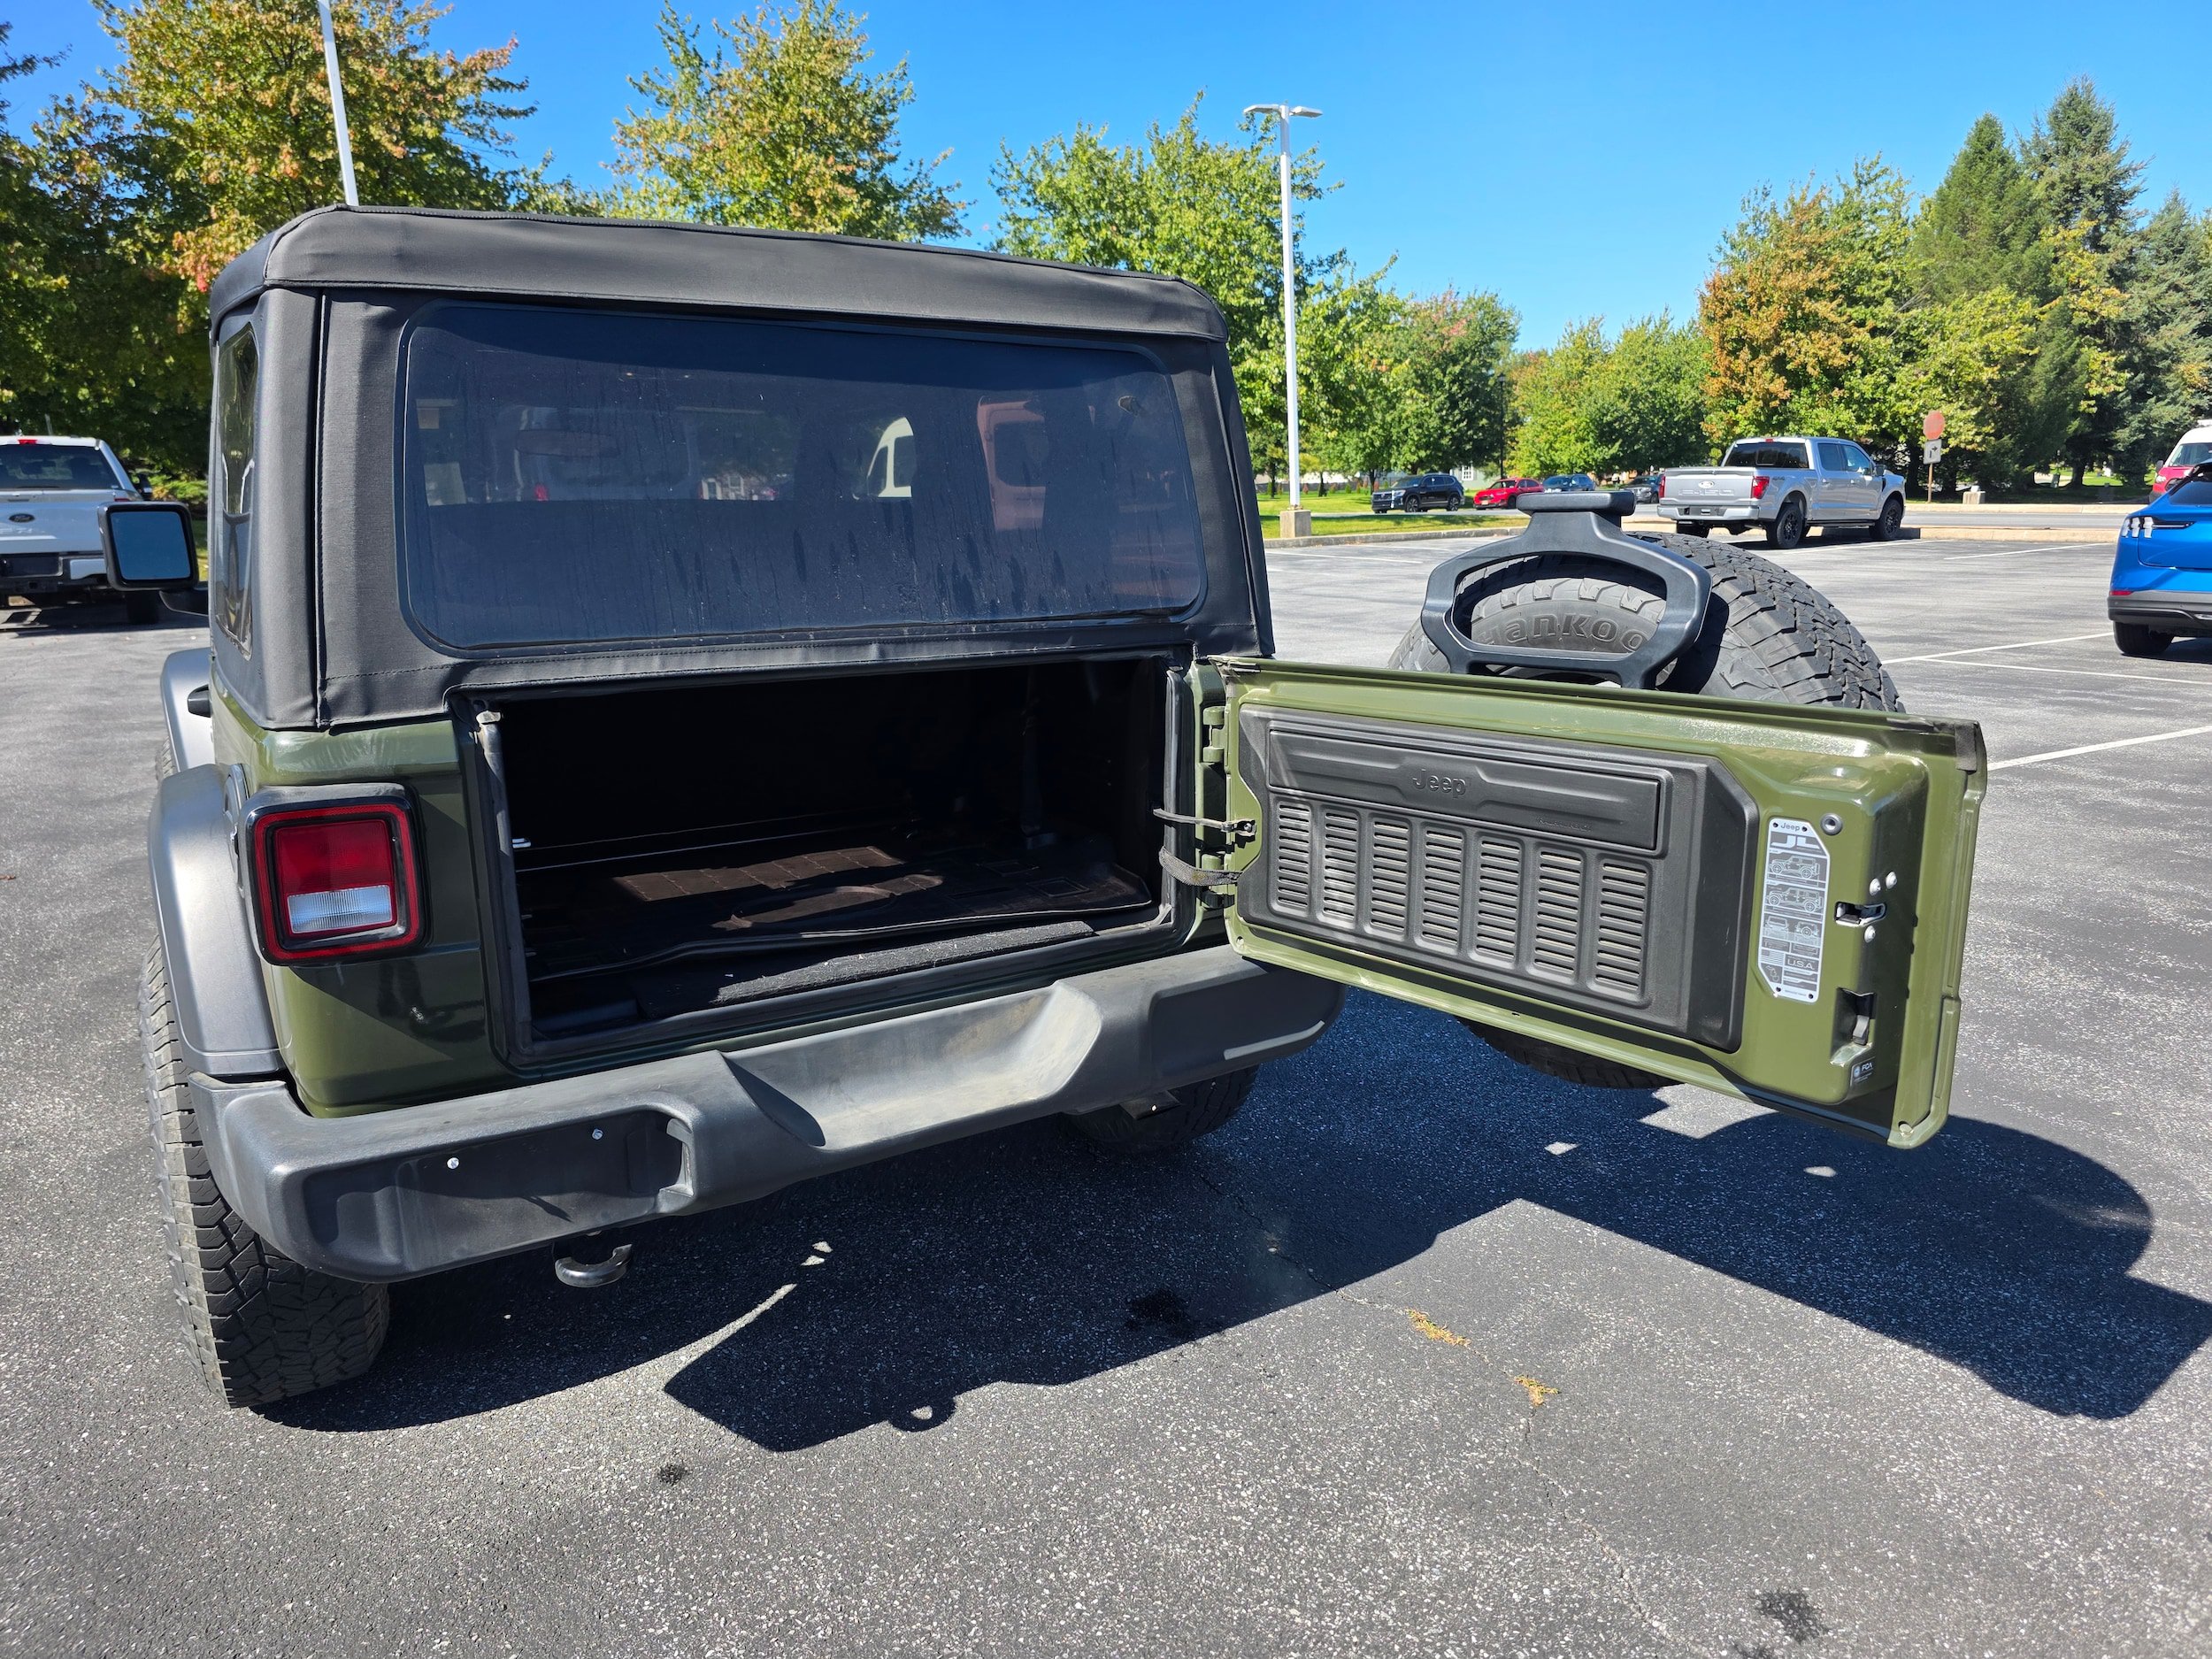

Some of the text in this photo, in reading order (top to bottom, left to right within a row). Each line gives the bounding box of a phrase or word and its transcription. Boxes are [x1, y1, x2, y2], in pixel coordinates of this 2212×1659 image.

[1412, 768, 1466, 799] Jeep
[1780, 822, 1801, 832] Jeep
[1770, 834, 1820, 849] JL
